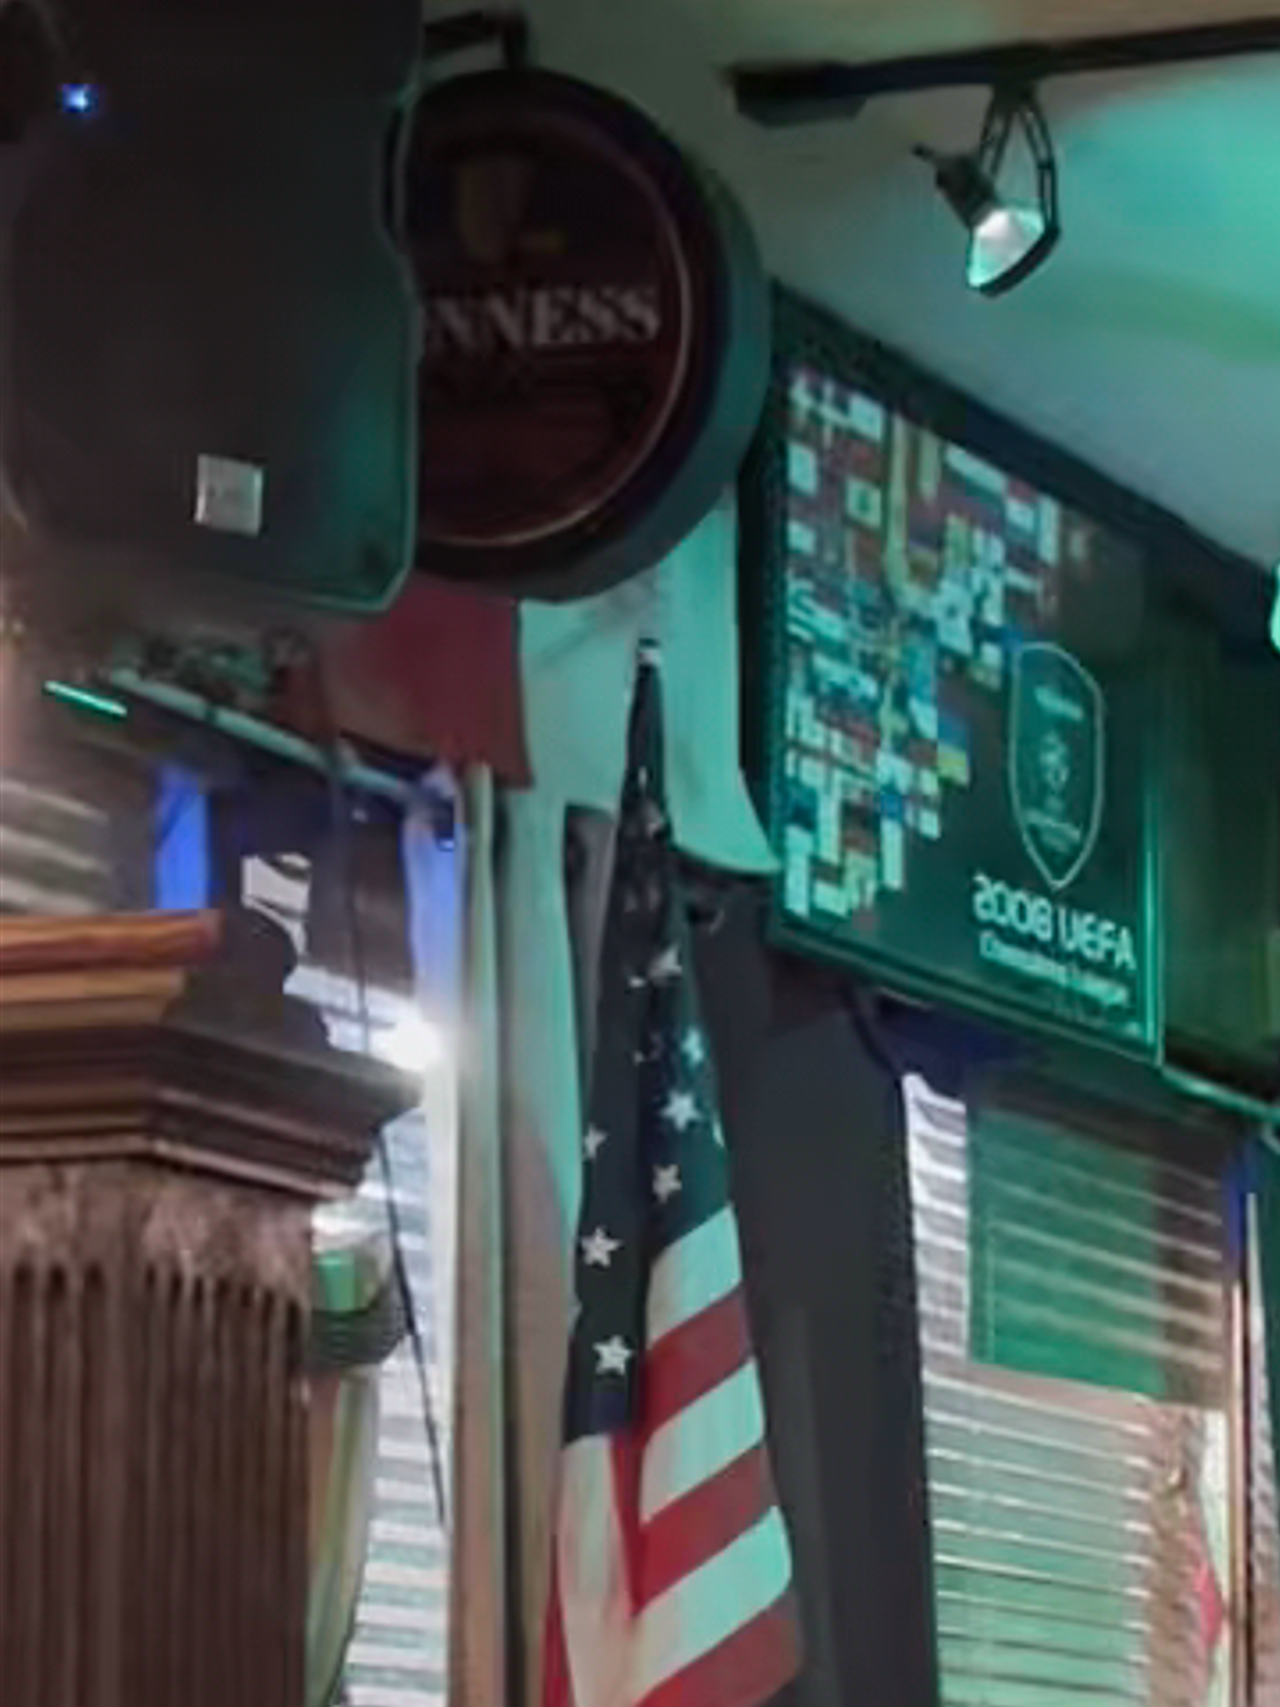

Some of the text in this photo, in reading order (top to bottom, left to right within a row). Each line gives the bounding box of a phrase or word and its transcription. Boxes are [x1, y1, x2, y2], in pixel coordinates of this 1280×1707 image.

[428, 285, 661, 349] NNESS
[973, 871, 1053, 942] 2008
[1057, 905, 1137, 971] UEFA
